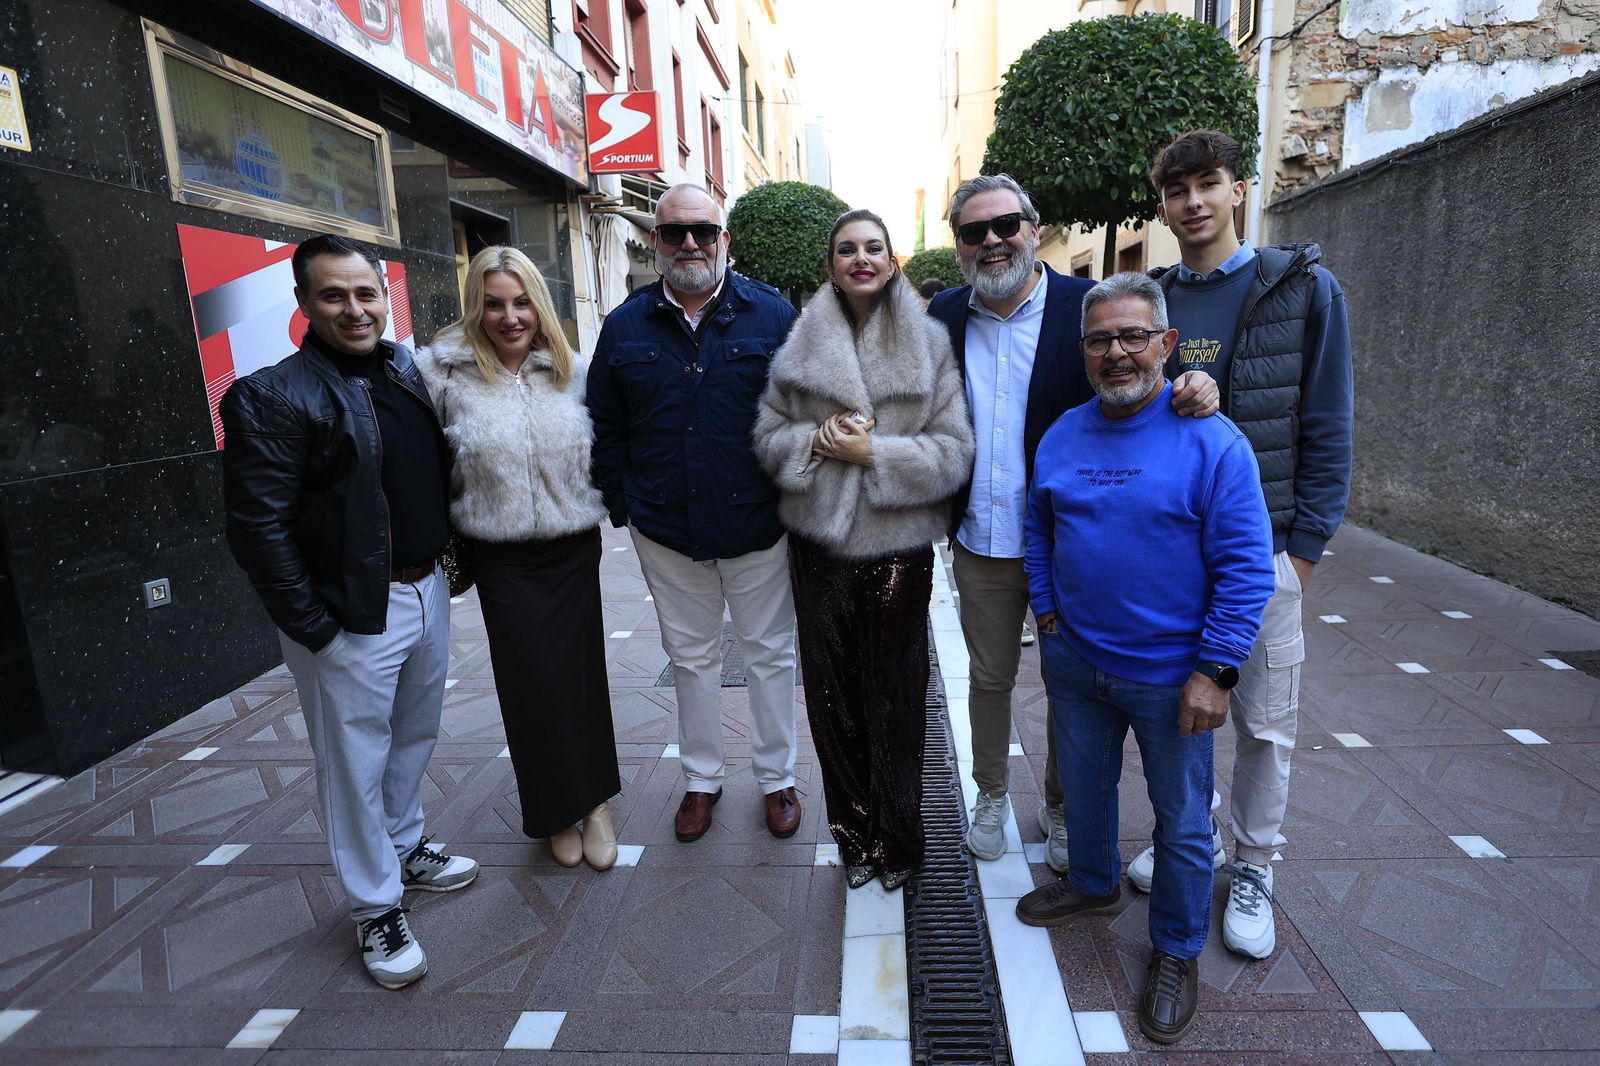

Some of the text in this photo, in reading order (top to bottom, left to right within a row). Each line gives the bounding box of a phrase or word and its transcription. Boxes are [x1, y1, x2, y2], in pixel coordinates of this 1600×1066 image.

[0, 129, 22, 143] UR
[595, 152, 654, 166] SPORTIUM
[1187, 337, 1209, 348] Just Be
[1179, 344, 1221, 364] Yourself
[1127, 469, 1142, 477] WAY
[1088, 479, 1097, 487] TO
